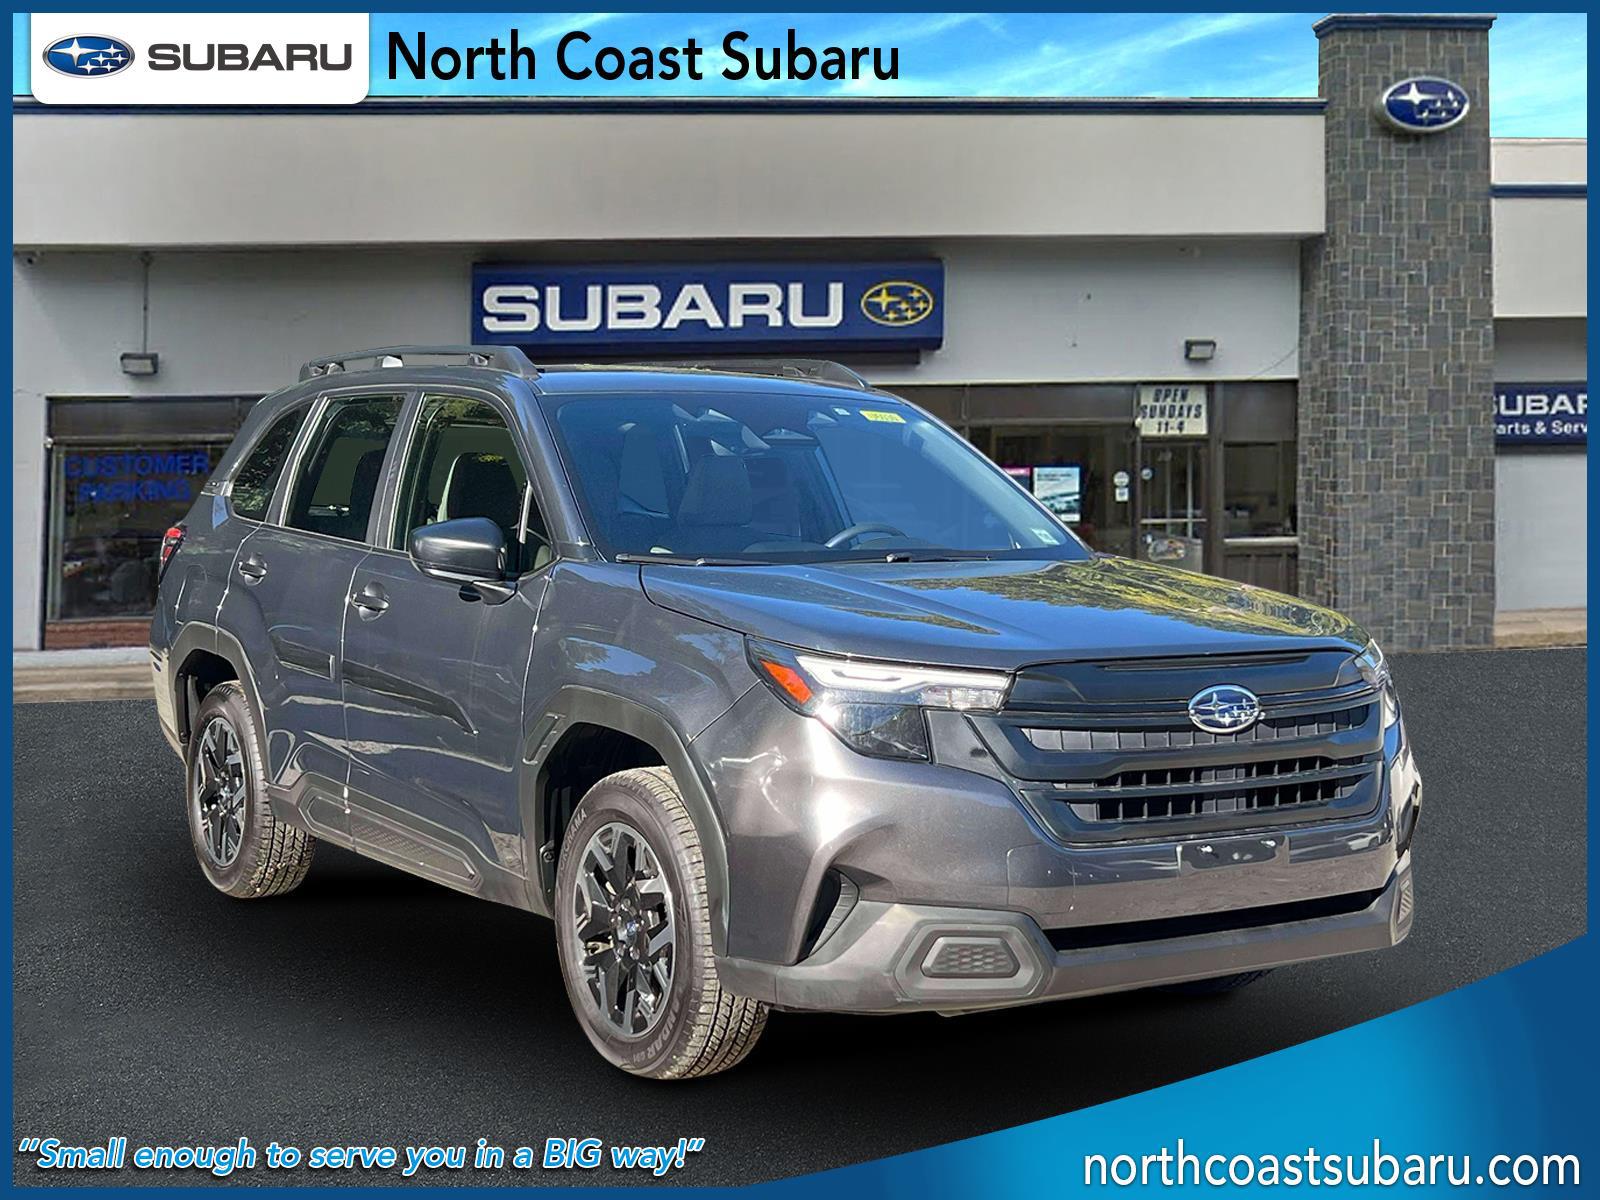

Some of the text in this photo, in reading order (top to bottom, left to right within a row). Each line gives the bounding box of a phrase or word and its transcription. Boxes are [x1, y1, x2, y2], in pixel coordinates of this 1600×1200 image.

[482, 282, 843, 332] SUBARU
[1153, 388, 1189, 402] OPEN
[1493, 394, 1587, 415] UBA
[1140, 404, 1203, 419] SUNDAYS
[1495, 422, 1530, 435] arts
[1535, 421, 1546, 435] &
[65, 453, 209, 478] CUSTOMER
[79, 479, 191, 502] PARKING
